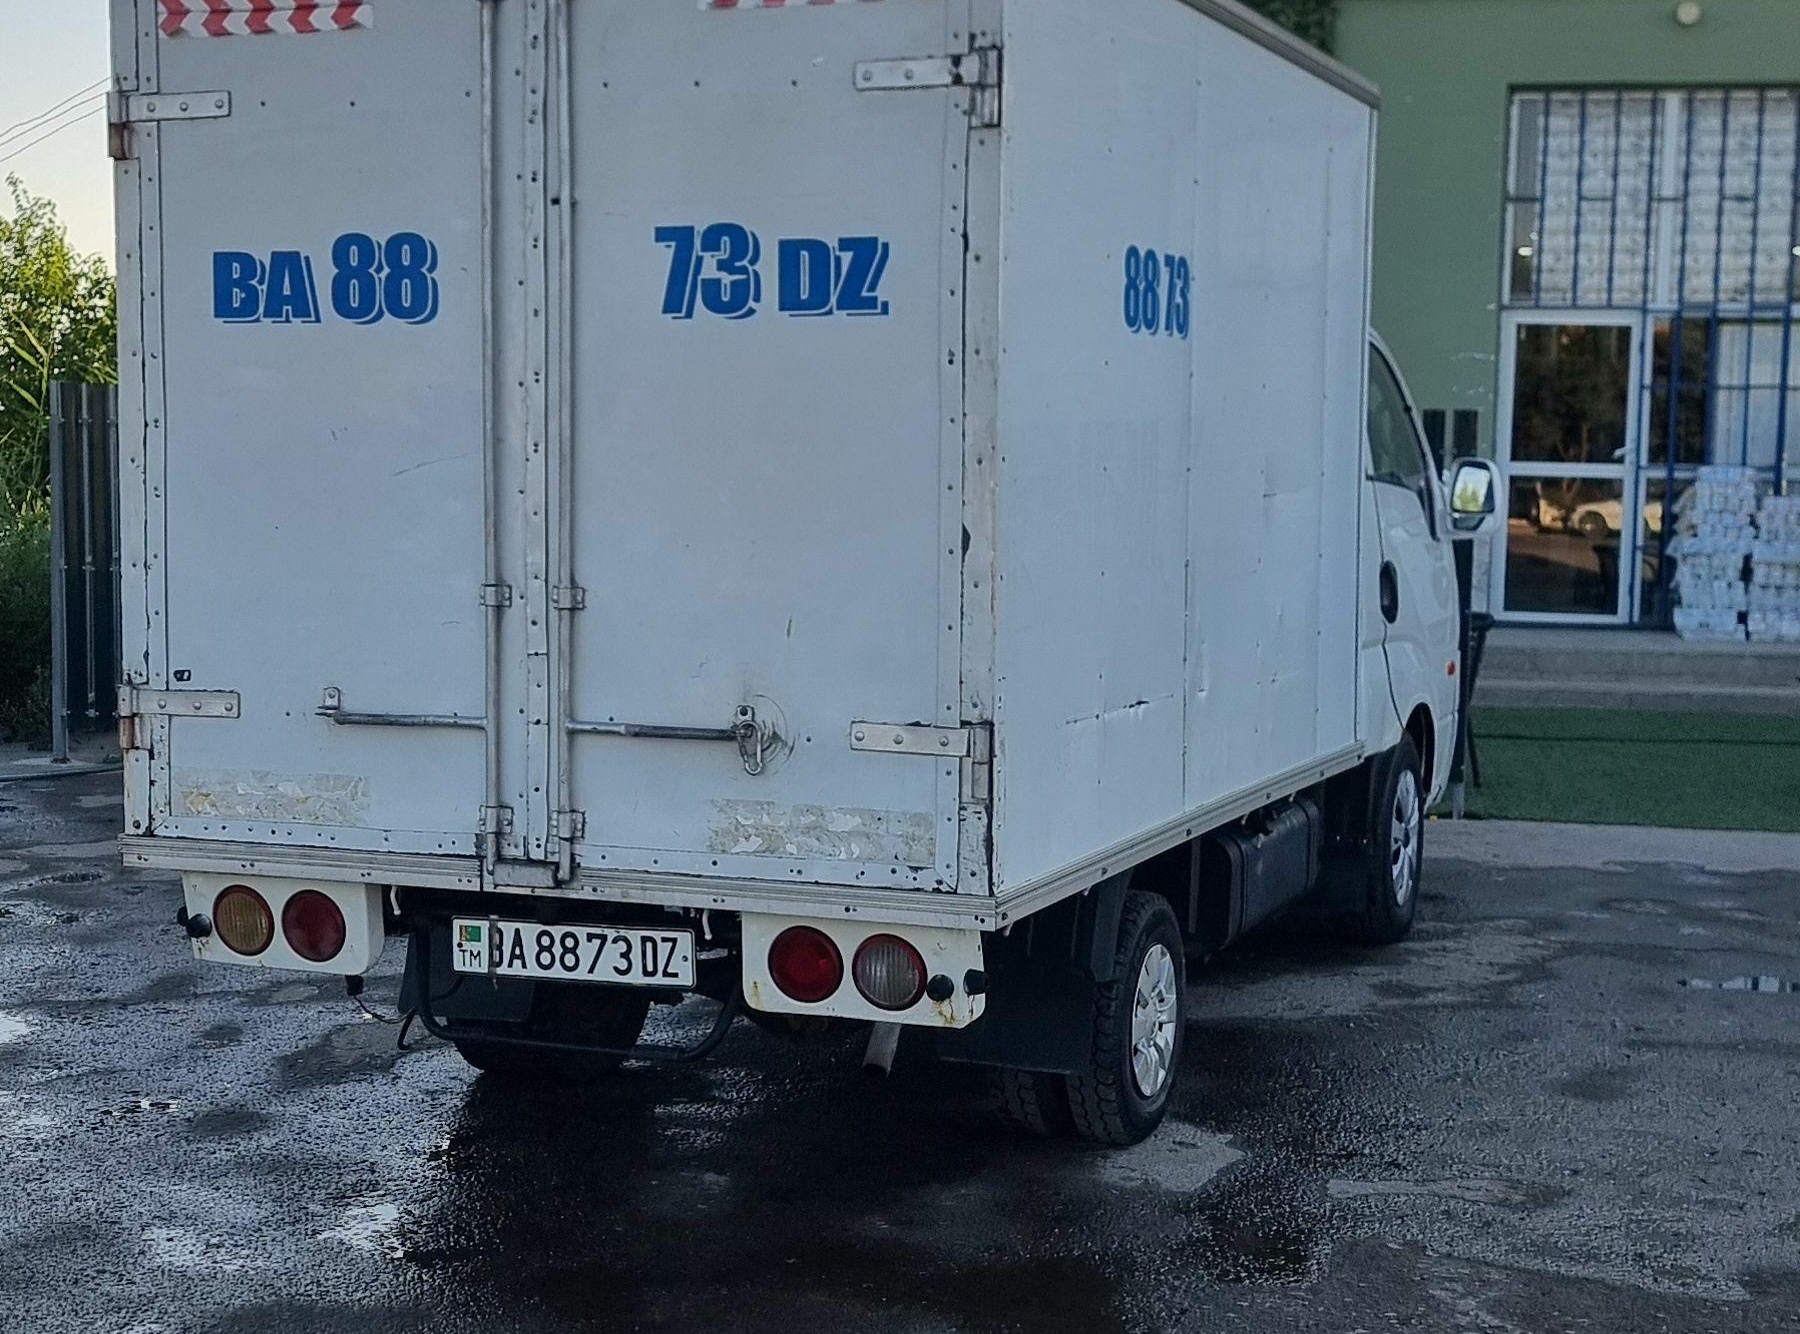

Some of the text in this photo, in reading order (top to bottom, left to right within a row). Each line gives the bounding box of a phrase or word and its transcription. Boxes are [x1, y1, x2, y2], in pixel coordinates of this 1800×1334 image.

[212, 231, 440, 325] BA 88
[654, 221, 890, 320] 73 DZ
[458, 948, 482, 968] TM
